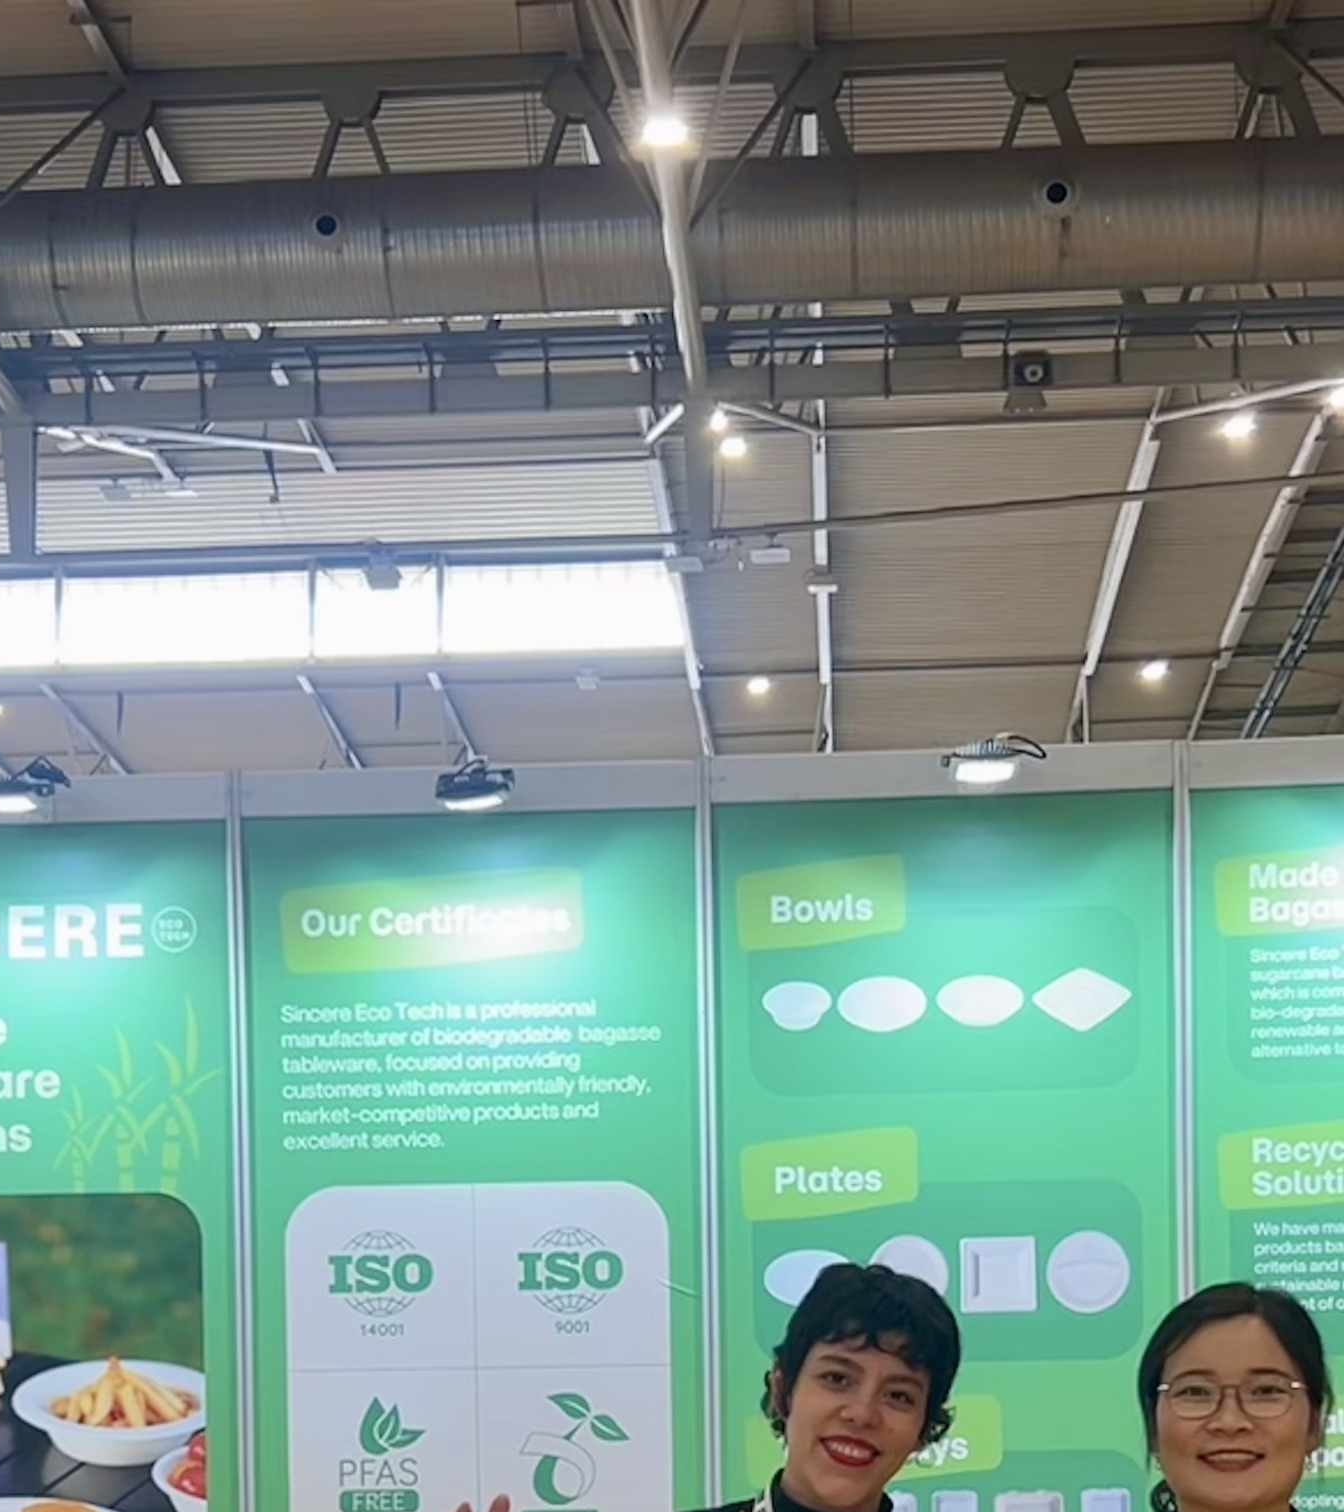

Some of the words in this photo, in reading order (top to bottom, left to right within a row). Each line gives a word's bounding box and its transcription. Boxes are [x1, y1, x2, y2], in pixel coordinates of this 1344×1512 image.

[1249, 861, 1338, 889] Made
[770, 893, 874, 923] Bowls
[300, 907, 362, 938] Our
[1249, 947, 1307, 964] Sincere
[1309, 946, 1340, 962] Eco
[1249, 966, 1331, 984] sugarcane
[1250, 986, 1295, 1001] which
[1297, 986, 1309, 1000] is
[280, 1004, 352, 1024] Sincere
[355, 1003, 393, 1022] Eco
[394, 1002, 444, 1021] Tech
[446, 1002, 462, 1020] is
[464, 1004, 478, 1020] a
[480, 999, 597, 1023] professional
[280, 1029, 408, 1049] manufacturer
[410, 1027, 431, 1046] of
[432, 1026, 573, 1049] biodegradable
[578, 1024, 662, 1047] bagasse
[1250, 1024, 1331, 1039] renewable
[1251, 1041, 1332, 1059] alternative
[281, 1055, 383, 1074] tableware,
[385, 1053, 463, 1072] focused
[465, 1054, 490, 1071] on
[492, 1050, 581, 1074] providing
[281, 1082, 383, 1100] customers
[384, 1079, 425, 1097] with
[427, 1076, 576, 1098] environmentally
[577, 1074, 652, 1097] friendly,
[282, 1103, 471, 1126] market-competitive
[472, 1102, 560, 1125] products
[562, 1101, 599, 1119] and
[282, 1131, 370, 1151] excellent
[371, 1130, 445, 1149] service.
[774, 1165, 884, 1194] Plates
[1253, 1222, 1281, 1237] We
[1282, 1221, 1320, 1236] have
[1253, 1240, 1323, 1258] products
[328, 1252, 435, 1294] ISO
[517, 1250, 624, 1291] ISO
[1253, 1259, 1306, 1275] criteria
[1309, 1258, 1339, 1273] and
[1317, 1296, 1335, 1311] of
[359, 1323, 405, 1338] 14001
[553, 1320, 590, 1335] 9001
[338, 1457, 420, 1488] PFAS
[351, 1491, 406, 1512] FREE
